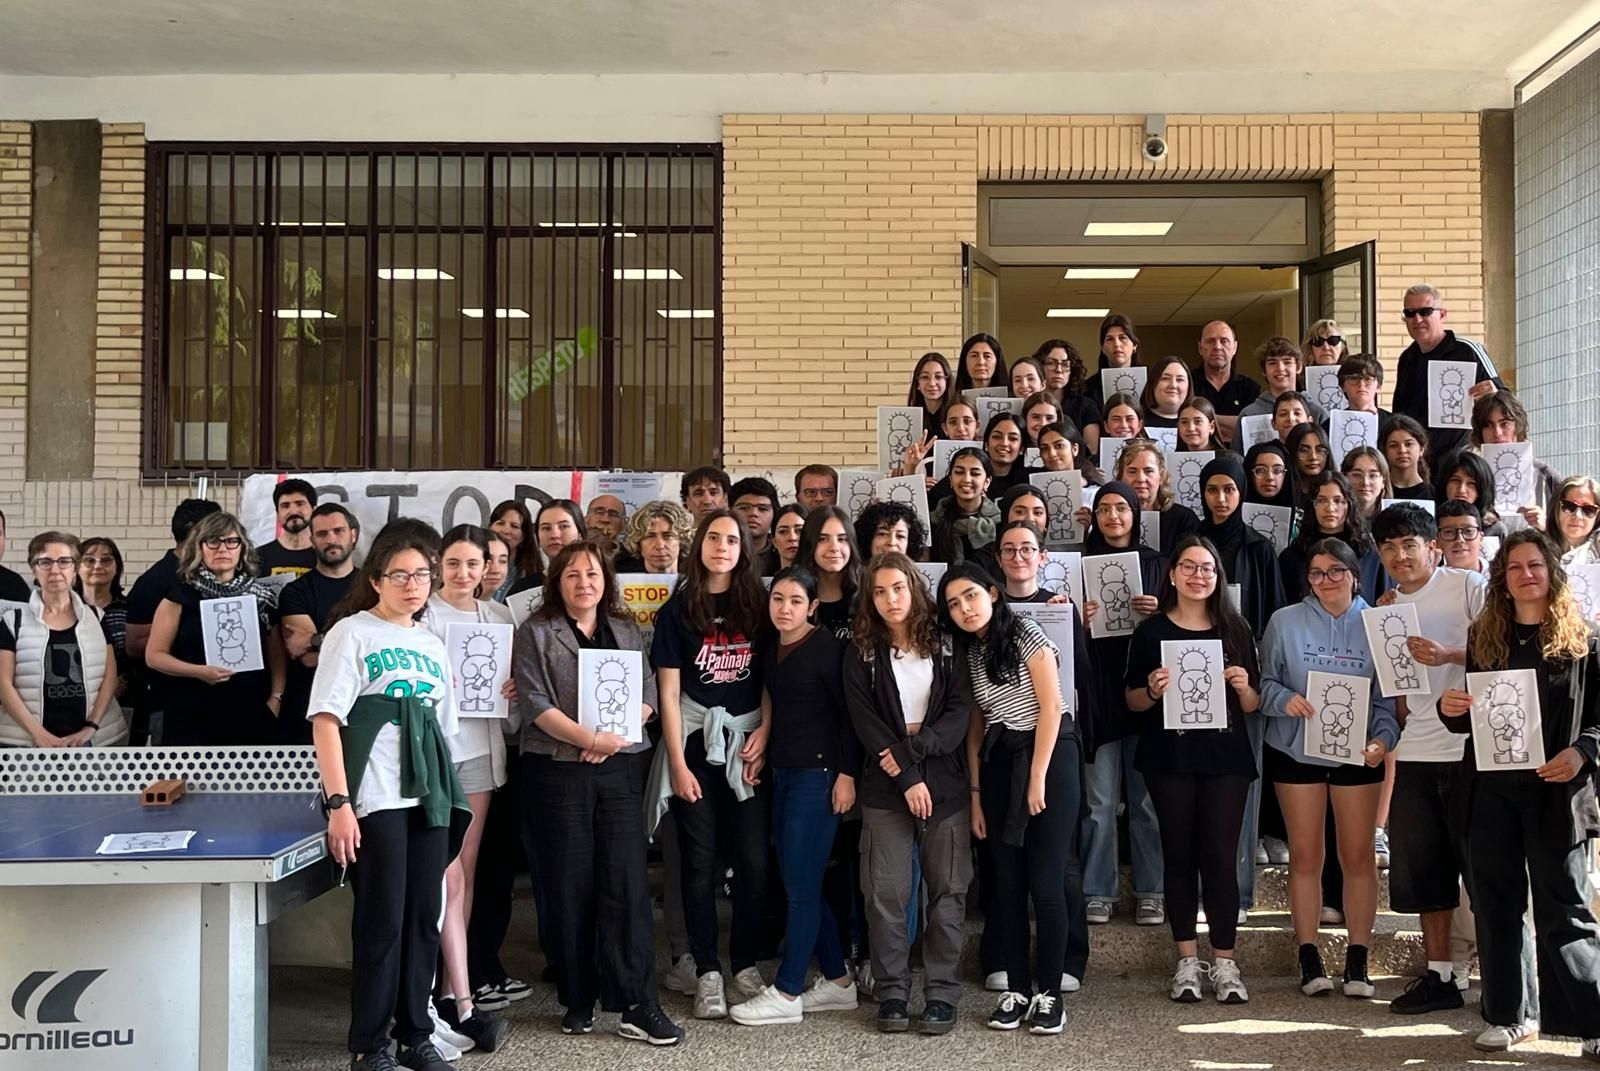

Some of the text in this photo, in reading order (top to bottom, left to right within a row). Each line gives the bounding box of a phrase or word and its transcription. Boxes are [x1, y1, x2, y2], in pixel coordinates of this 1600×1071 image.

[624, 588, 669, 601] STOP
[1306, 644, 1365, 656] TOMMY
[694, 645, 752, 671] 4 Patinaje
[1304, 657, 1364, 669] HILFIGER
